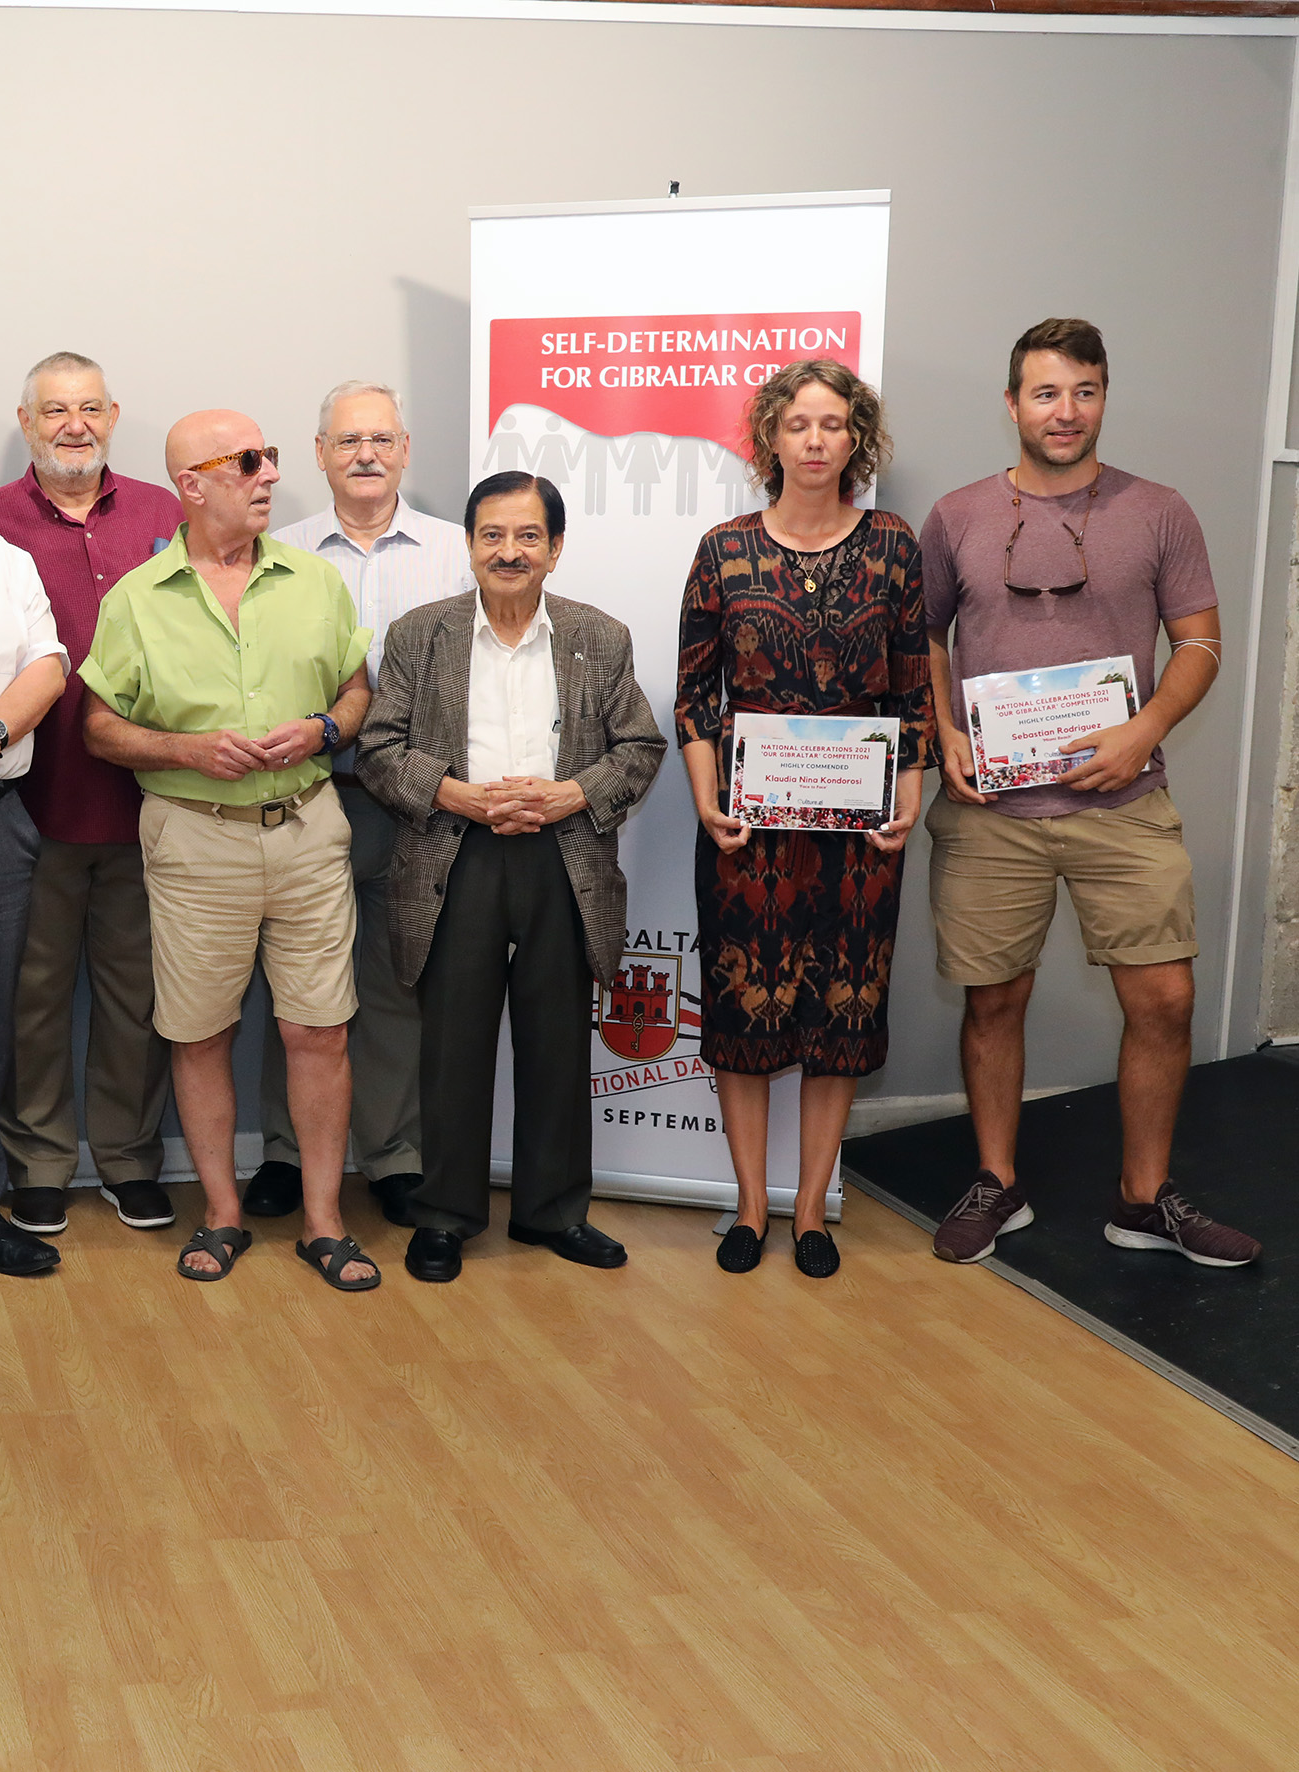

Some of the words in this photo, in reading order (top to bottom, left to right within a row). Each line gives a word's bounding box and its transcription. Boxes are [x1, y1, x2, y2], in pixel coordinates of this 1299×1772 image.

[541, 328, 846, 355] SELF-DETERMINATION
[541, 366, 592, 388] FOR
[600, 364, 736, 388] GIBRALTAR
[995, 700, 1033, 710] NATIONAL
[1036, 692, 1091, 704] CELEBRATIONS
[1061, 697, 1109, 708] COMPETITION
[1019, 717, 1044, 725] HIGHLY
[1046, 710, 1090, 721] COMMENDED
[1012, 730, 1054, 741] Sebastian
[1057, 722, 1101, 735] Rodriguez
[591, 1066, 668, 1094] TIONAL
[675, 1058, 715, 1077] DA
[604, 1108, 725, 1133] SEPTEMB
